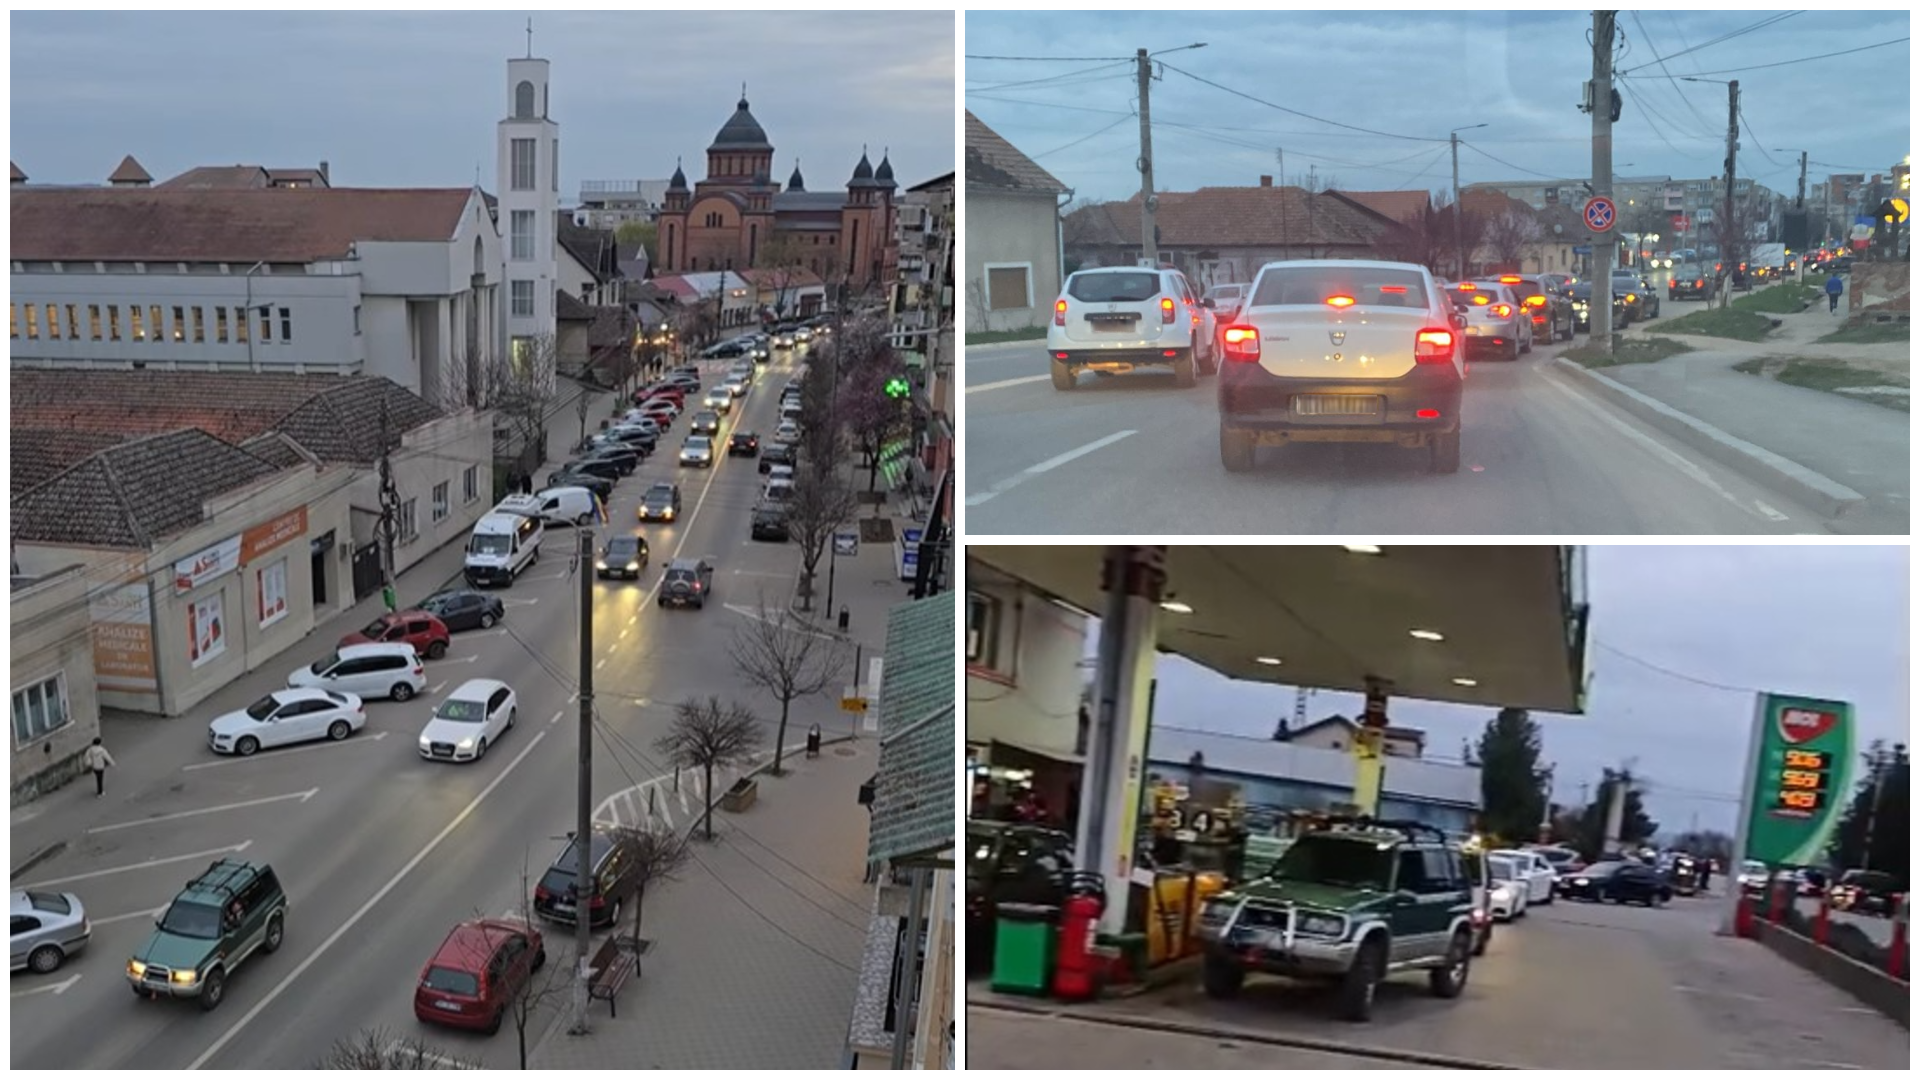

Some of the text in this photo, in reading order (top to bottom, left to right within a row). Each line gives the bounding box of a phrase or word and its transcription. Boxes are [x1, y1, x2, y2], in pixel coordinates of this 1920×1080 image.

[97, 625, 148, 640] ANALIZE
[98, 639, 148, 653] MEDICALE
[1193, 813, 1207, 832] 4
